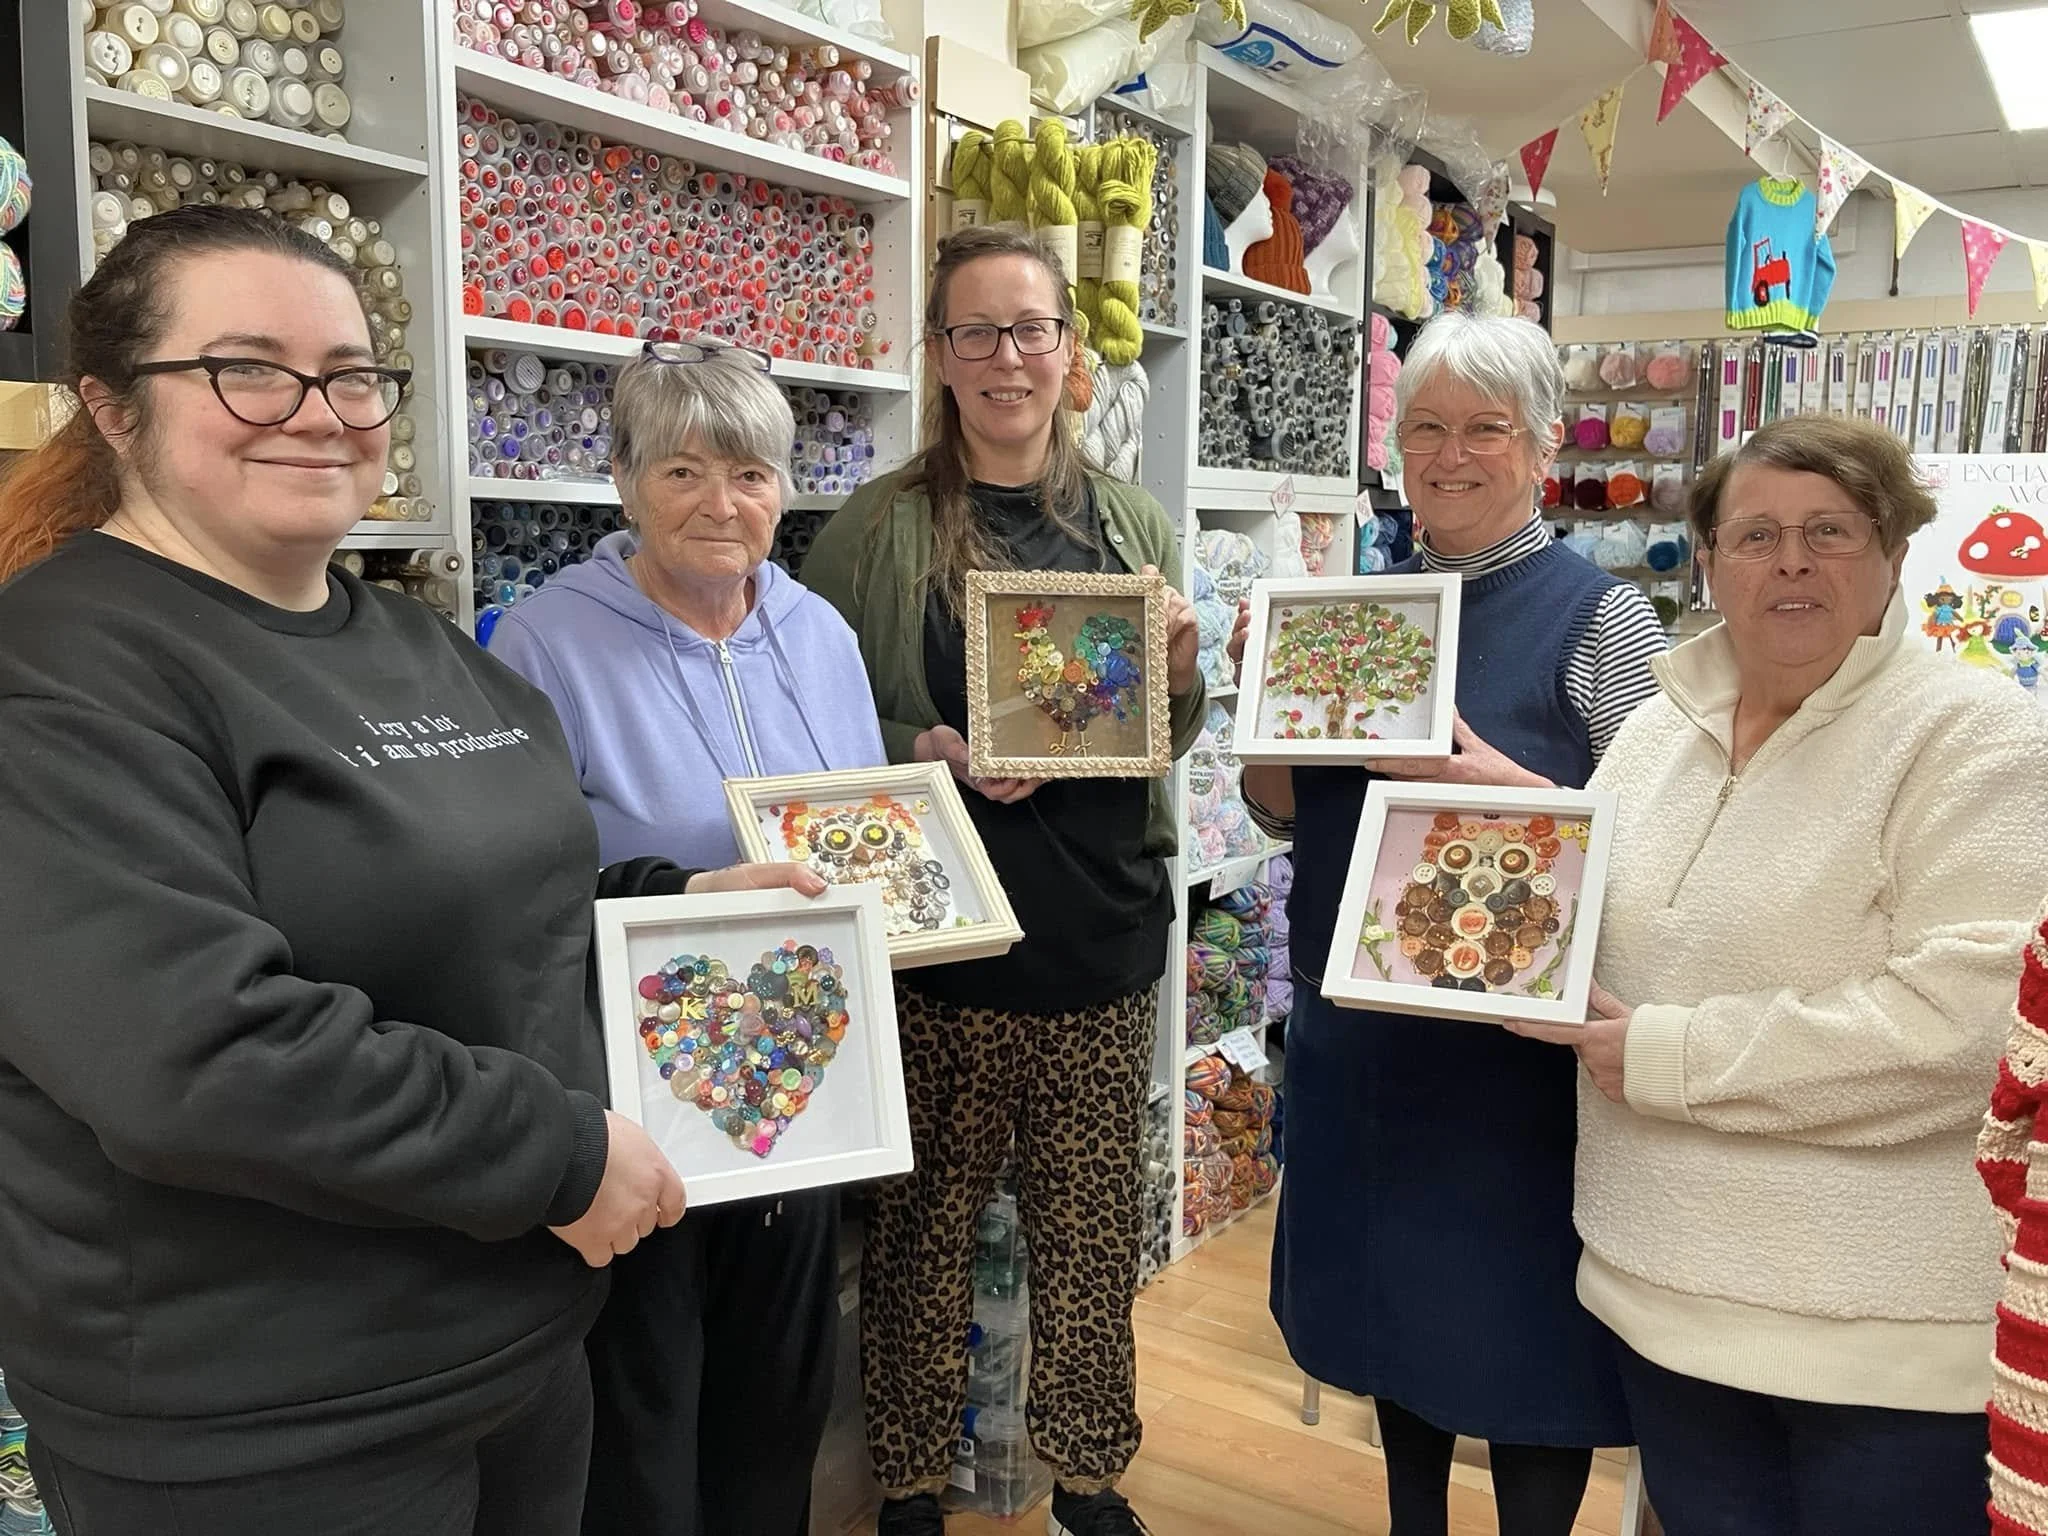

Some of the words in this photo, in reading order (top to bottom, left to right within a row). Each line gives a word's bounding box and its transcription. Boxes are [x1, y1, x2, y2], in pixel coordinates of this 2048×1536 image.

[359, 714, 381, 735] i
[379, 722, 414, 740] cry
[412, 720, 430, 734] a
[422, 714, 461, 732] lot
[355, 745, 381, 767] i
[382, 743, 418, 759] am
[415, 742, 440, 757] so
[438, 727, 530, 759] productive
